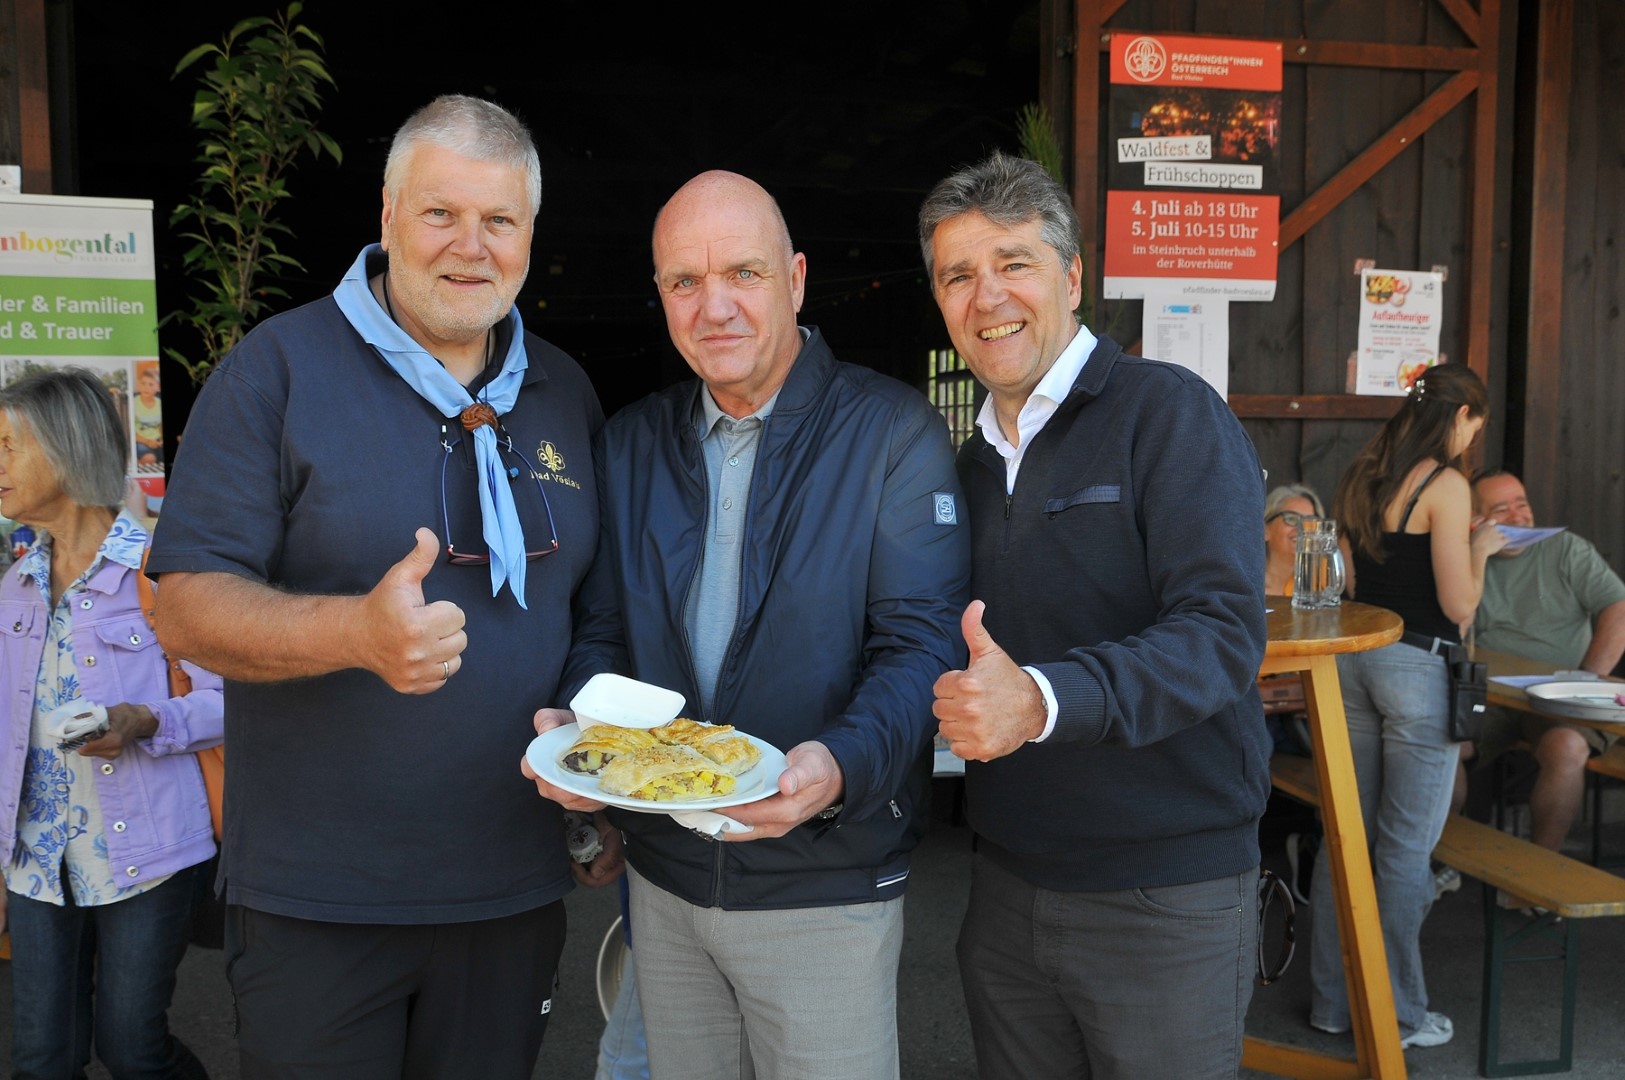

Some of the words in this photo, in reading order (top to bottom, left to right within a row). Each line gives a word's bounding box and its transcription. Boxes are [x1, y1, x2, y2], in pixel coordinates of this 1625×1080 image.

[1171, 62, 1229, 76] ÖSTERREICH
[1121, 142, 1190, 159] Waldfest
[1195, 141, 1209, 156] &
[1147, 166, 1256, 188] Frühschoppen
[1131, 200, 1147, 216] 4.
[1150, 199, 1180, 219] Juli
[1184, 202, 1204, 217] ab
[1208, 203, 1226, 217] 18
[1230, 203, 1259, 218] Uhr
[1131, 221, 1147, 237] 5.
[1150, 221, 1180, 240] Juli
[1185, 223, 1225, 238] 10-15
[1230, 223, 1259, 239] Uhr
[1132, 244, 1147, 255] im
[1149, 244, 1206, 256] Steinbruch
[1208, 245, 1257, 257] unterhalb
[1156, 258, 1175, 269] der
[1177, 258, 1233, 270] Roverhütte
[0, 295, 25, 313] er
[32, 295, 49, 313] &
[56, 296, 144, 315] Familien
[20, 321, 38, 339] &
[43, 322, 113, 340] Trauer
